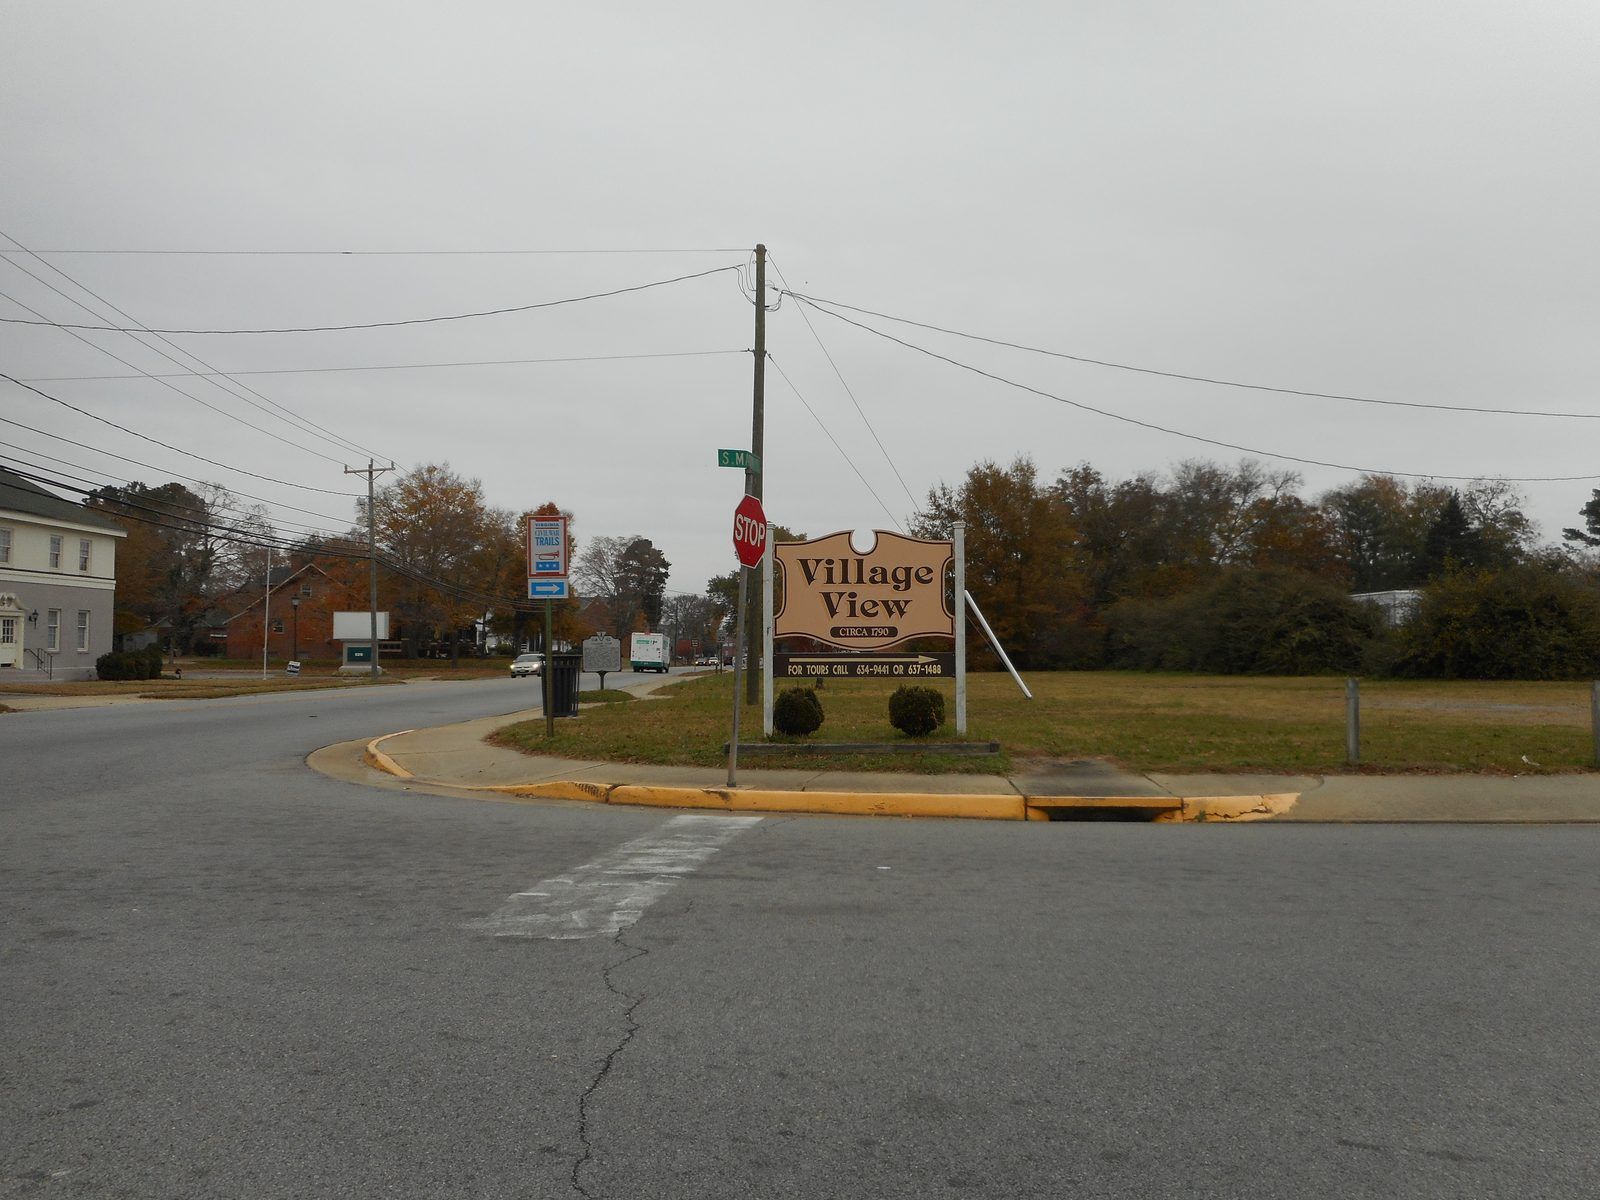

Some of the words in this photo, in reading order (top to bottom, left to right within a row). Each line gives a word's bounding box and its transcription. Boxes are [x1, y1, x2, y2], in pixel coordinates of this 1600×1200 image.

[735, 513, 765, 547] STOP
[535, 537, 560, 546] TRAILS
[797, 558, 934, 591] Village
[819, 592, 913, 619] View
[839, 627, 867, 637] CIRCA
[870, 627, 889, 637] 1790
[788, 665, 802, 675] FOR
[806, 665, 829, 675] TOURS
[833, 665, 848, 675] CALL
[857, 665, 889, 675] 634-9441
[893, 665, 904, 675] OR
[908, 665, 942, 675] 637-1488
